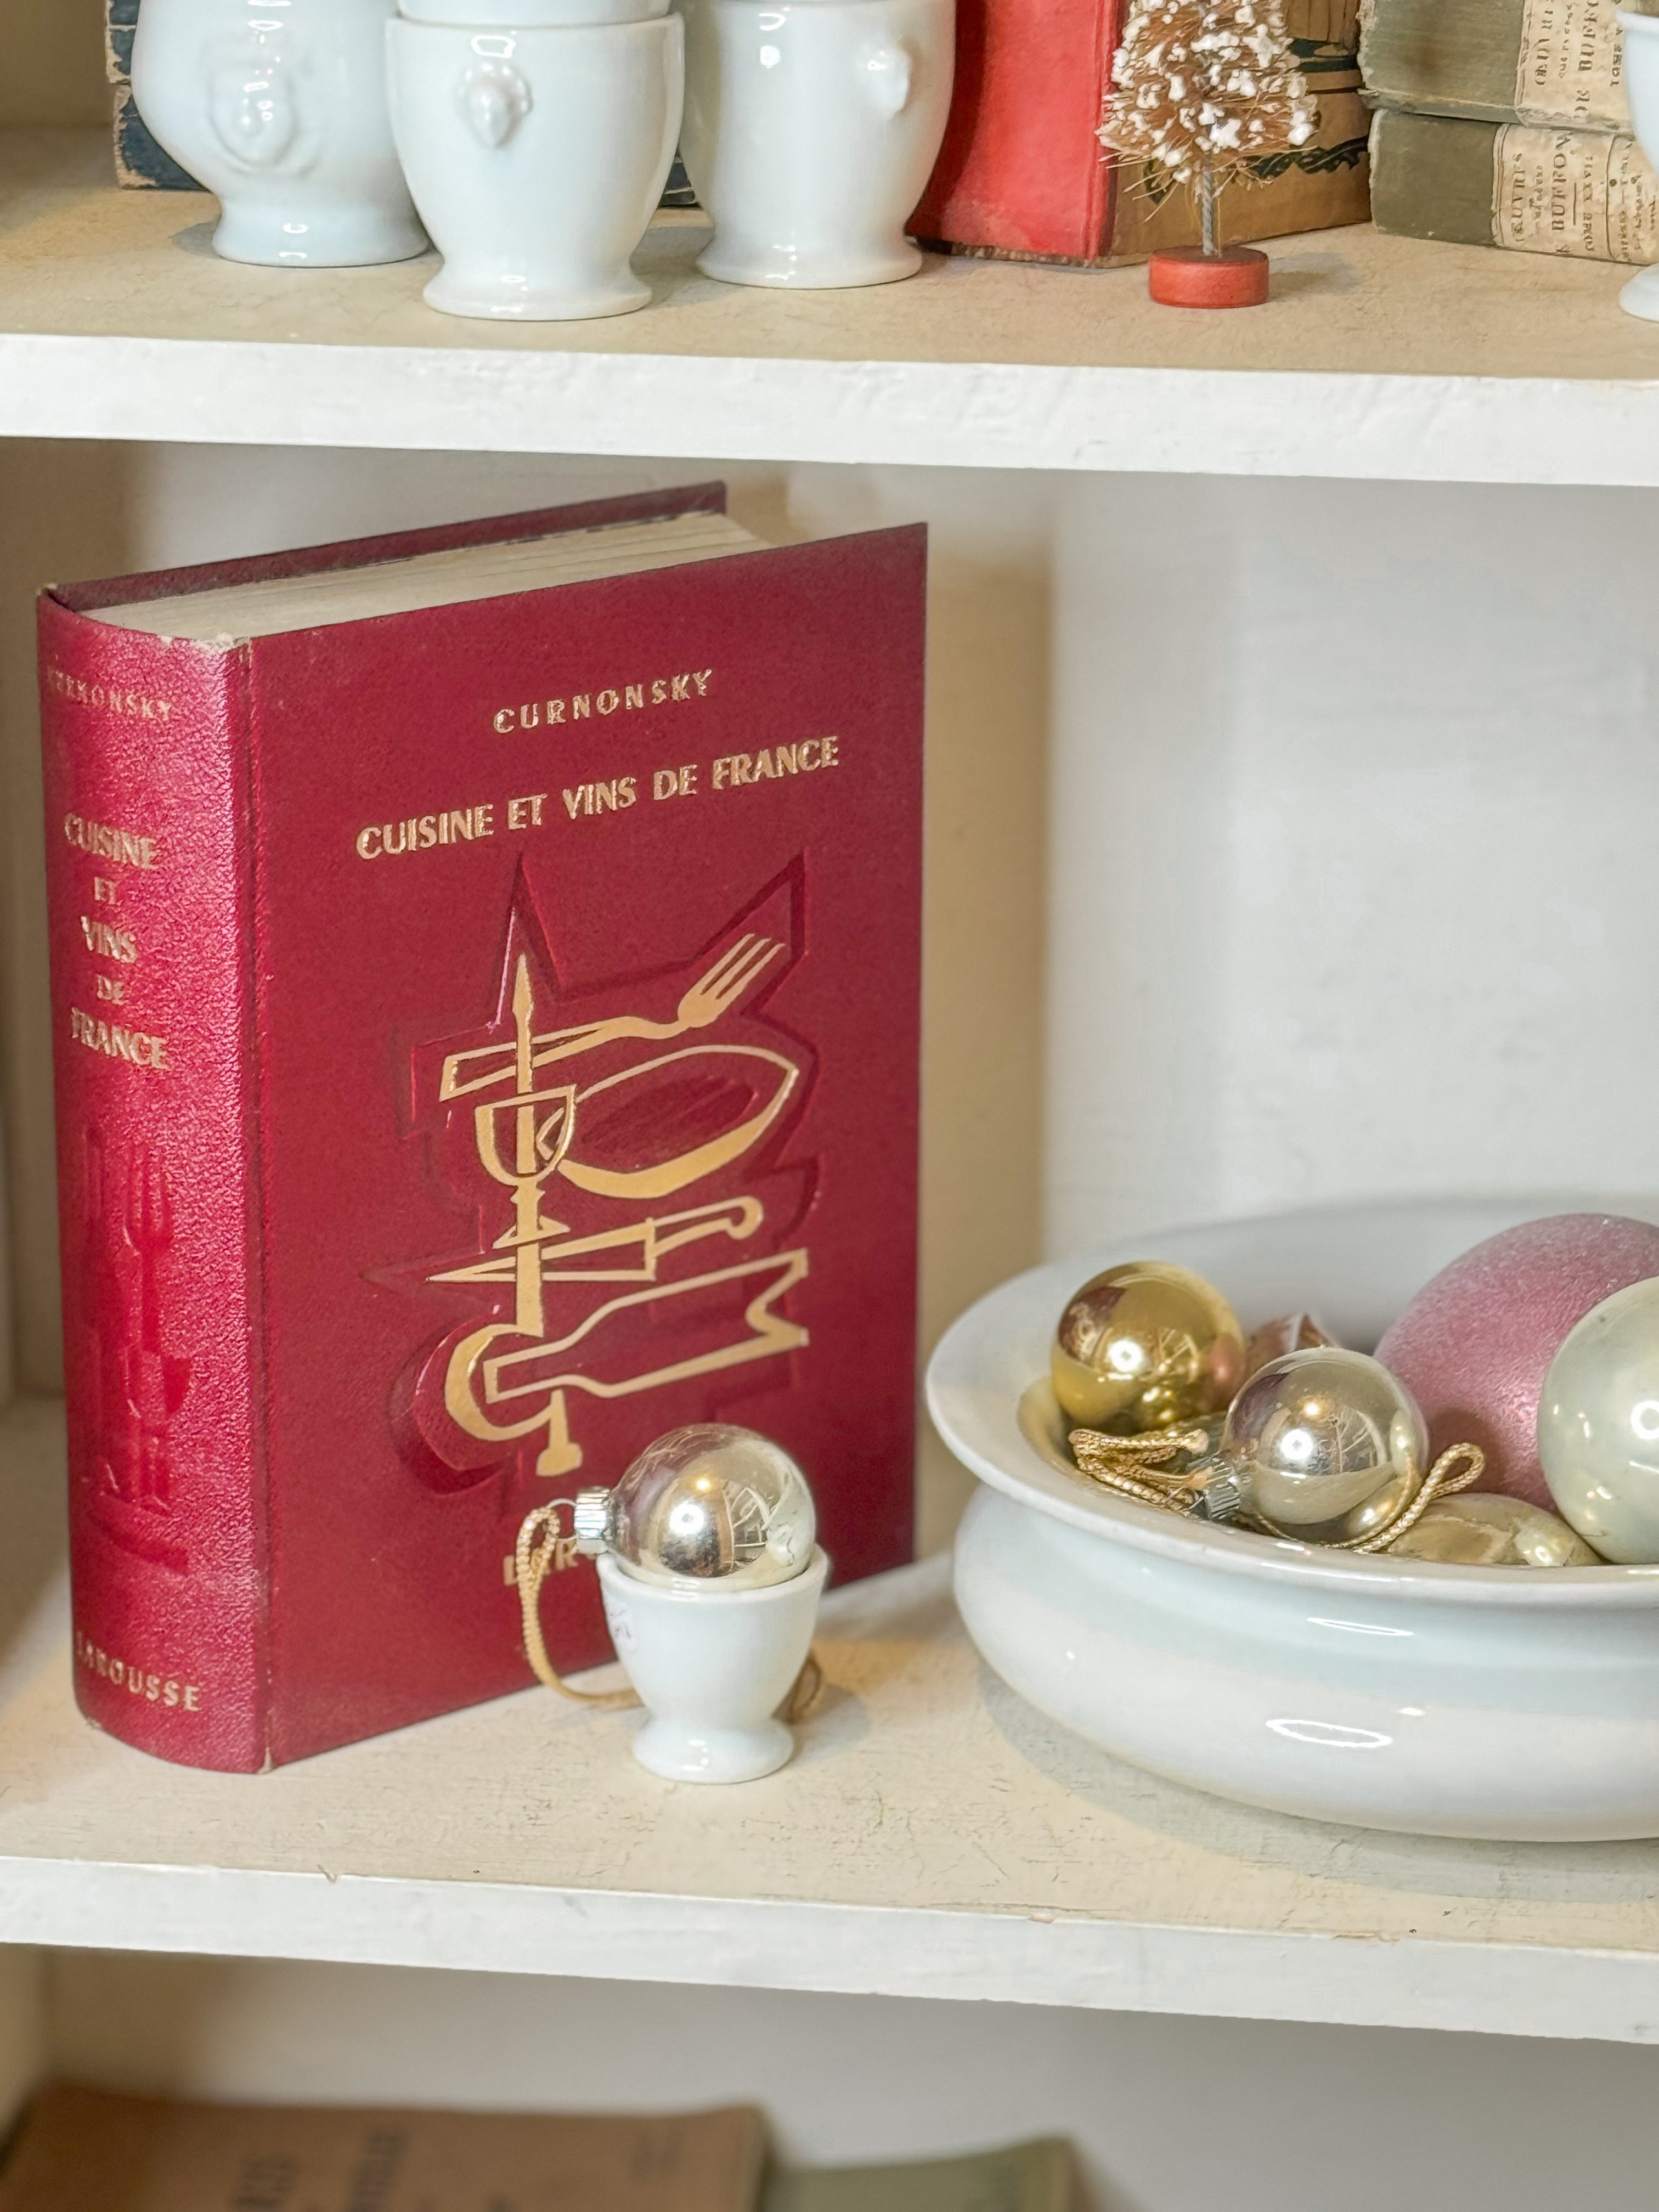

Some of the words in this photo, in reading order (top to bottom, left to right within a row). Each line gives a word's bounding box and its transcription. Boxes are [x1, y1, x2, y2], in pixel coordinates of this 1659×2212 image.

[493, 668, 712, 733] CURNONSKY
[356, 803, 494, 860] CUISINE
[507, 793, 548, 830] ET
[562, 776, 637, 820] VINS
[653, 764, 698, 801] DE
[712, 736, 839, 791] FRANCE
[64, 812, 161, 870] CUISINE
[94, 876, 119, 905] ET
[81, 915, 138, 964] VINS
[97, 974, 126, 1005] DE
